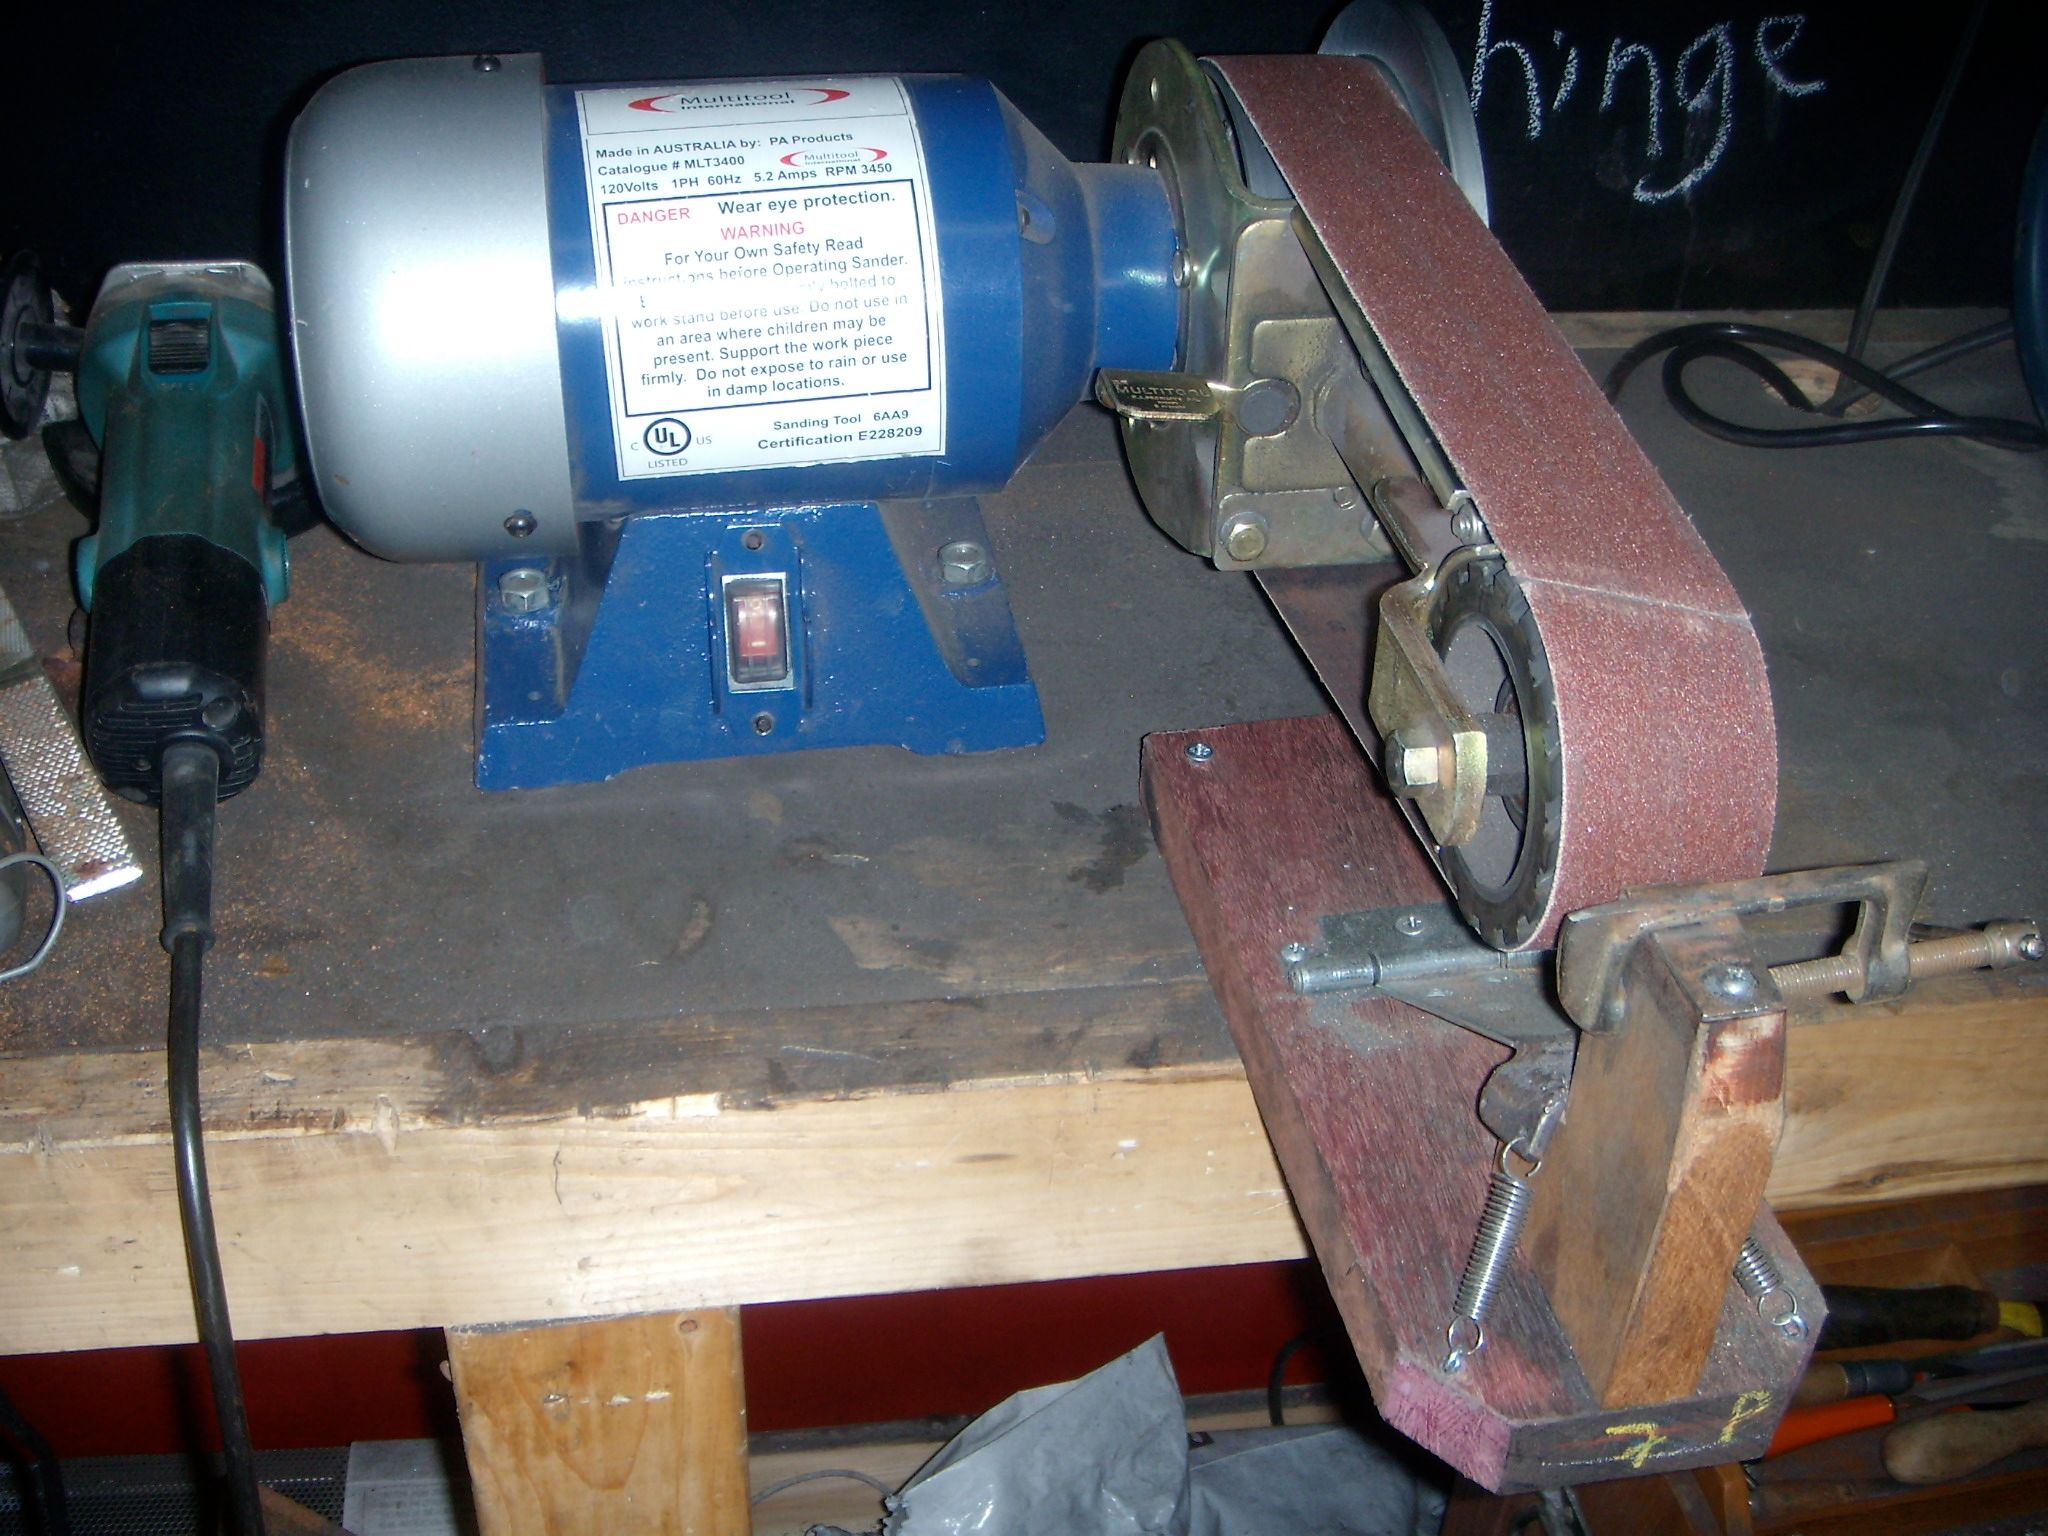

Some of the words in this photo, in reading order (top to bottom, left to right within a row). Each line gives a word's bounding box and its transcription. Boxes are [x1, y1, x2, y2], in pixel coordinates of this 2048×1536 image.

[681, 91, 790, 106] Multitool
[1470, 0, 1827, 203] hinge
[596, 148, 633, 159] Made
[637, 147, 650, 156] in
[653, 140, 737, 155] AUSTRALIA
[740, 139, 761, 149] by:
[769, 136, 788, 146] PA
[792, 133, 853, 144] Products
[804, 151, 859, 161] Multitool
[598, 163, 668, 176] Catalogue
[672, 161, 681, 170] #
[684, 155, 745, 169] MLT3400
[600, 181, 659, 195] 120Volts
[672, 177, 699, 189] 1PH
[707, 174, 742, 186] 60Hz
[754, 171, 774, 182] 5.2
[777, 169, 817, 182] Amps
[825, 165, 857, 176] RPM
[861, 163, 892, 174] 3450
[617, 207, 691, 225] DANGER
[718, 200, 762, 215] Wear
[768, 199, 798, 213] eye
[804, 190, 896, 211] protection.
[720, 221, 805, 241] WARNING
[665, 252, 690, 266] For
[694, 250, 729, 263] Your
[734, 246, 768, 259] Own
[773, 242, 820, 256] Safety
[825, 236, 864, 251] Read
[719, 266, 767, 280] before
[773, 259, 847, 277] Operating
[852, 254, 908, 269] Sander.
[881, 276, 896, 286] to
[631, 316, 668, 329] work
[809, 300, 830, 313] Do
[835, 298, 859, 310] not
[864, 296, 889, 308] use
[657, 335, 675, 347] an
[680, 332, 712, 344] area
[716, 327, 762, 342] where
[767, 321, 828, 336] children
[833, 318, 864, 332] may
[869, 315, 886, 327] be
[653, 350, 714, 369] present.
[719, 344, 780, 361] Support
[784, 341, 808, 354] the
[812, 337, 849, 351] work
[854, 334, 893, 350] piece
[641, 371, 687, 386] firmly.
[696, 368, 717, 381] Do
[722, 366, 746, 378] not
[751, 361, 804, 377] expose
[809, 359, 824, 371] to
[829, 355, 857, 368] rain
[862, 354, 877, 366] or
[881, 352, 907, 364] use
[707, 386, 721, 398] in
[726, 383, 768, 396] damp
[772, 376, 845, 392] locations.
[773, 418, 829, 430] Sanding
[833, 414, 862, 425] Tool
[873, 410, 909, 421] 6AA9
[654, 427, 681, 448] UL
[696, 435, 712, 445] US
[758, 433, 853, 449] Certification
[858, 426, 923, 441] E228209
[648, 458, 688, 469] LISTED
